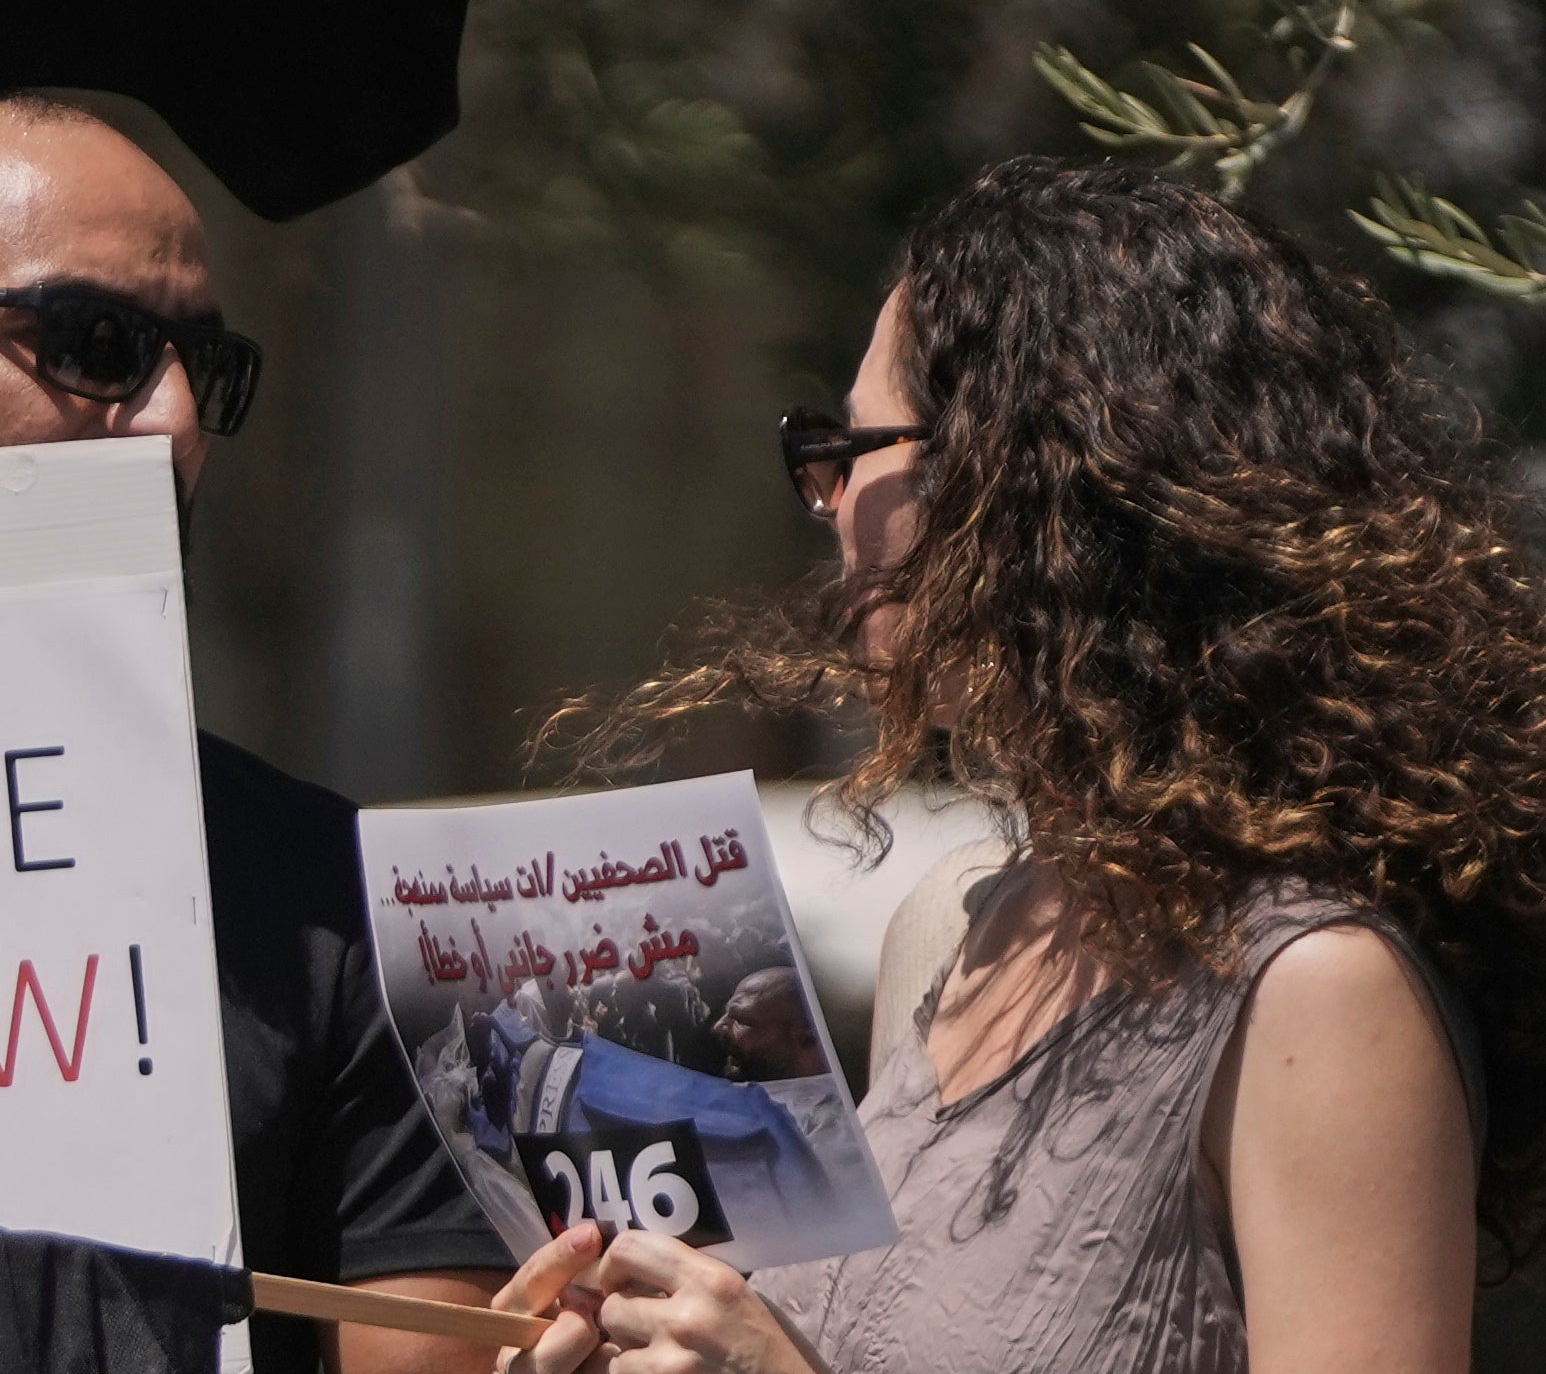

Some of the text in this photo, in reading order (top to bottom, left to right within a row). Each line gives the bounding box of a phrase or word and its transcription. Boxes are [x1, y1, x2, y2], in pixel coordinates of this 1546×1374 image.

[446, 862, 514, 913] سياسة
[694, 827, 749, 886] قتل
[470, 917, 493, 994] أو
[497, 929, 557, 1009] جانبي
[564, 922, 619, 987] ضرر
[627, 912, 699, 980] مش
[545, 1140, 700, 1238] 246
